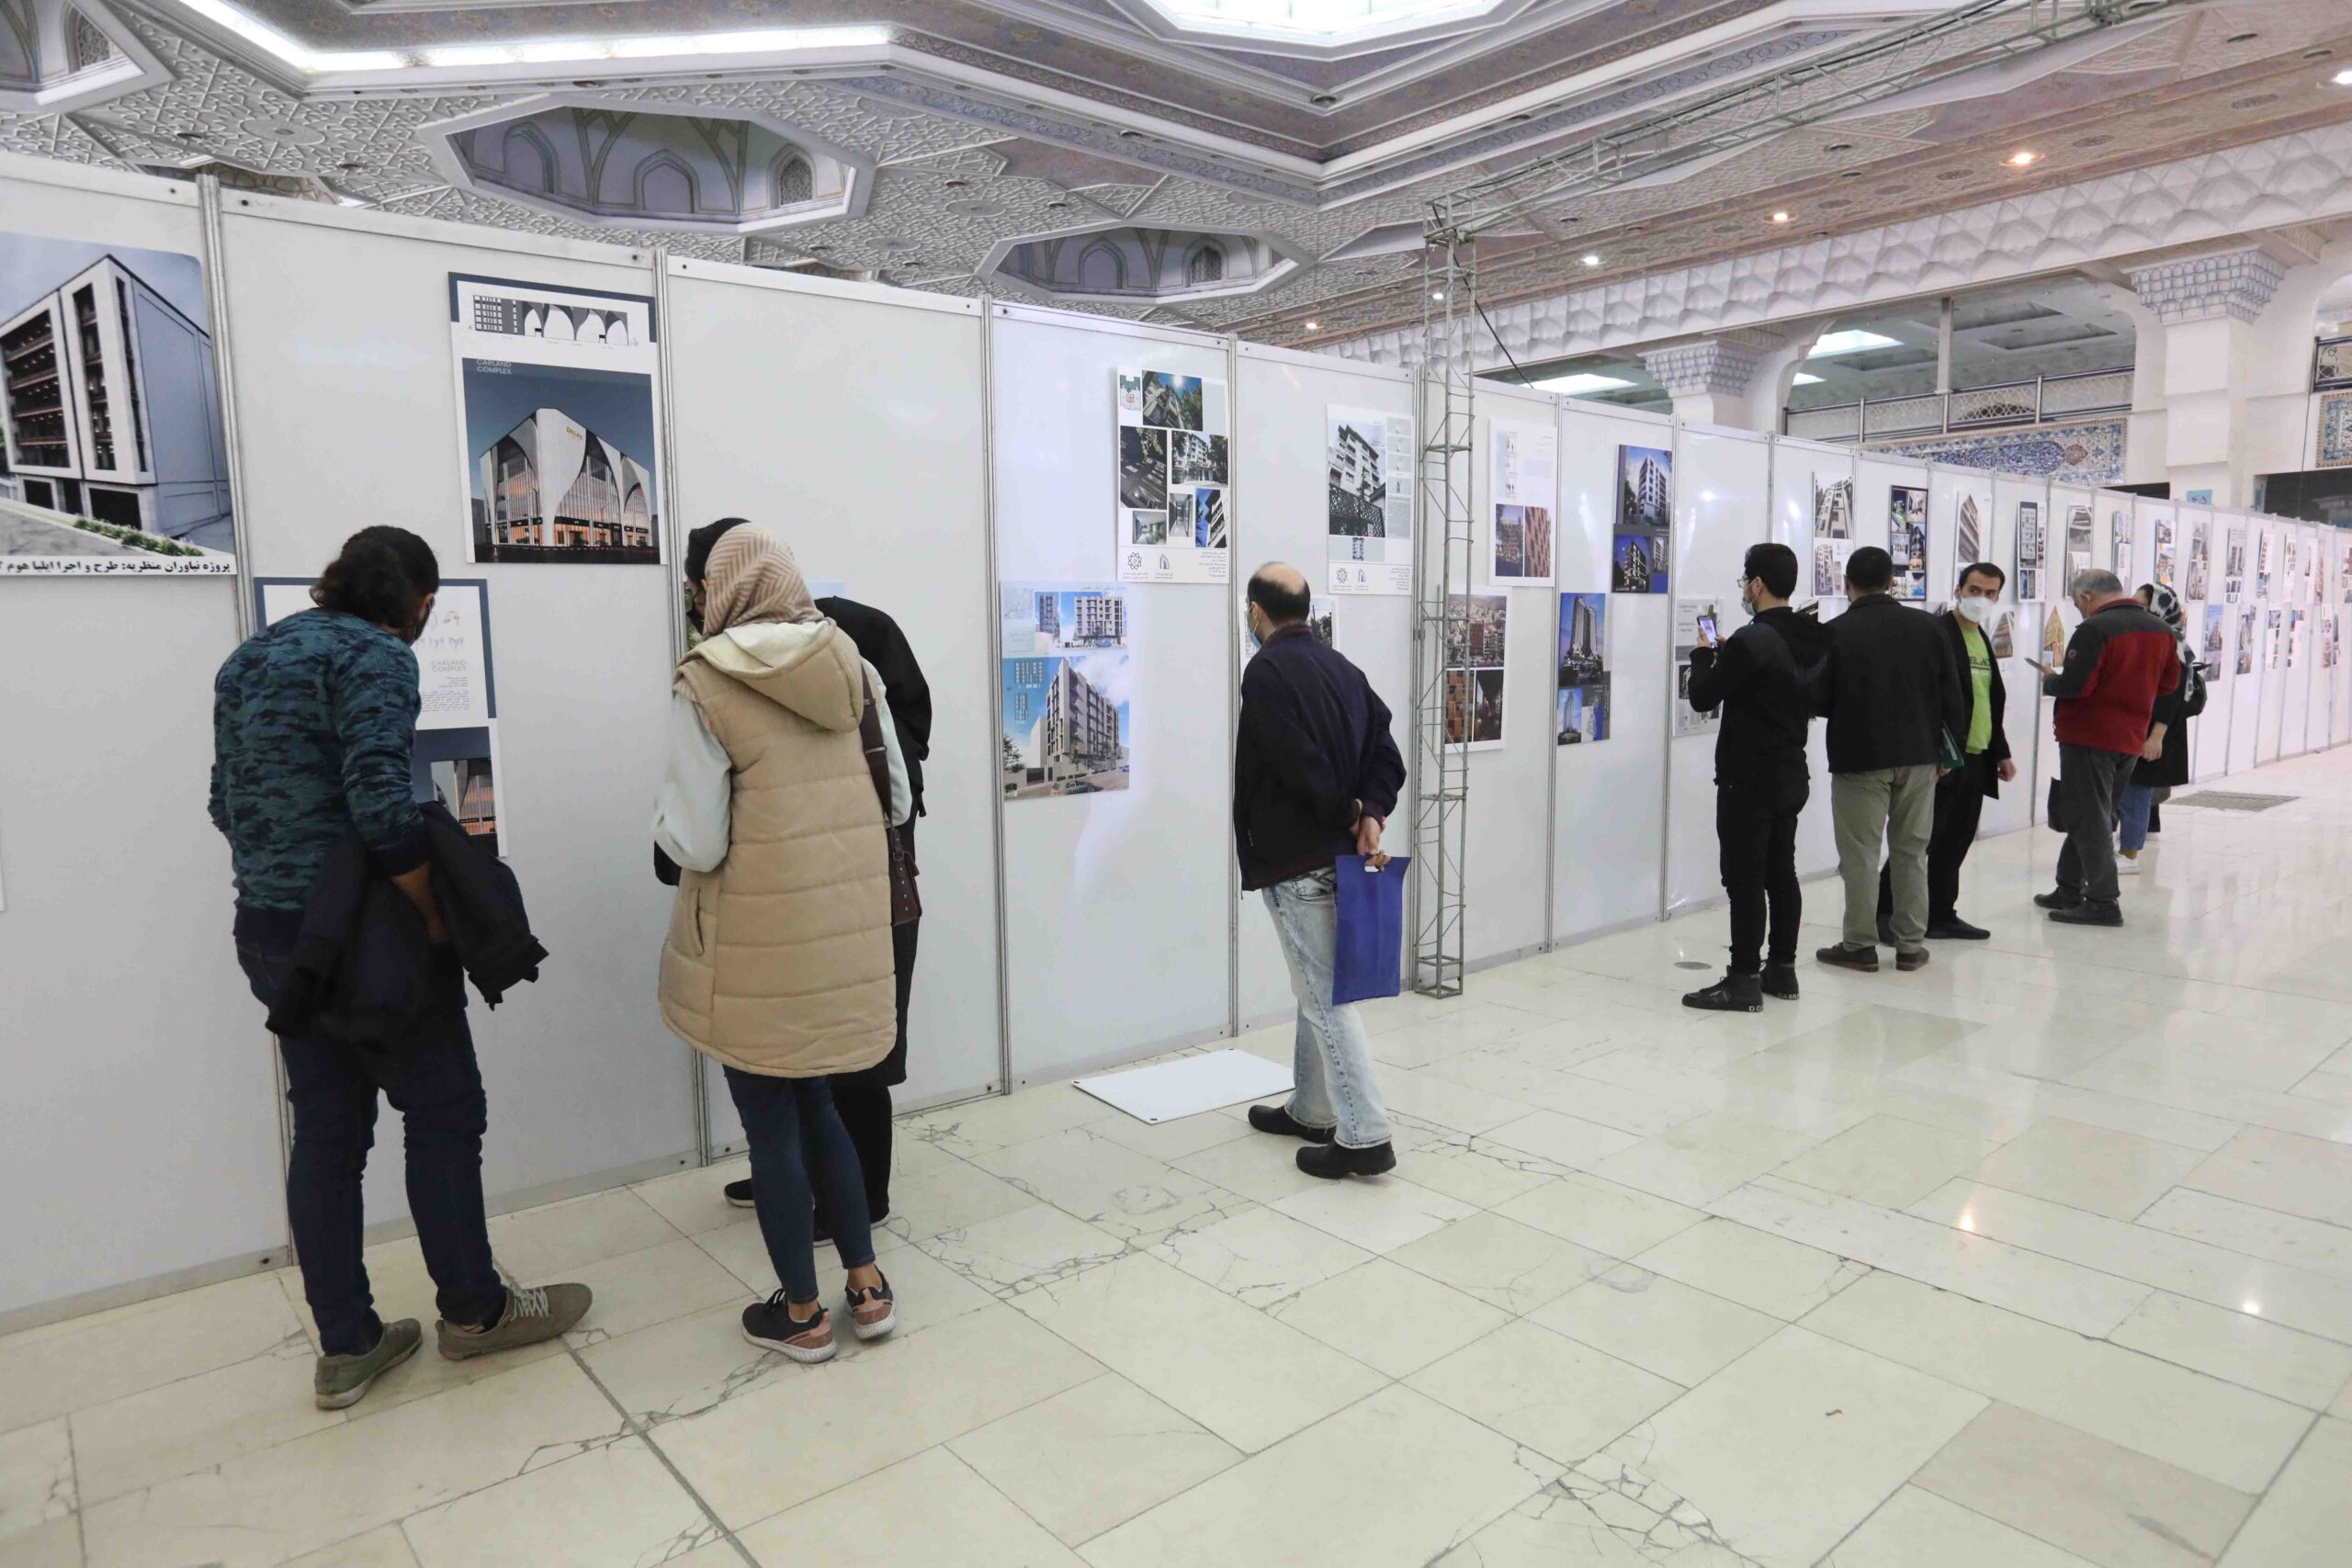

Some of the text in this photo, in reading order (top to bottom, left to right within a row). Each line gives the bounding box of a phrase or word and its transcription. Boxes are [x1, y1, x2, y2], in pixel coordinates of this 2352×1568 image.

[477, 367, 513, 375] COMPLEX
[56, 560, 81, 573] اجرا
[85, 564, 91, 573] و
[94, 560, 119, 573] طرح
[164, 560, 200, 572] نیاوران
[202, 561, 231, 573] پروژه
